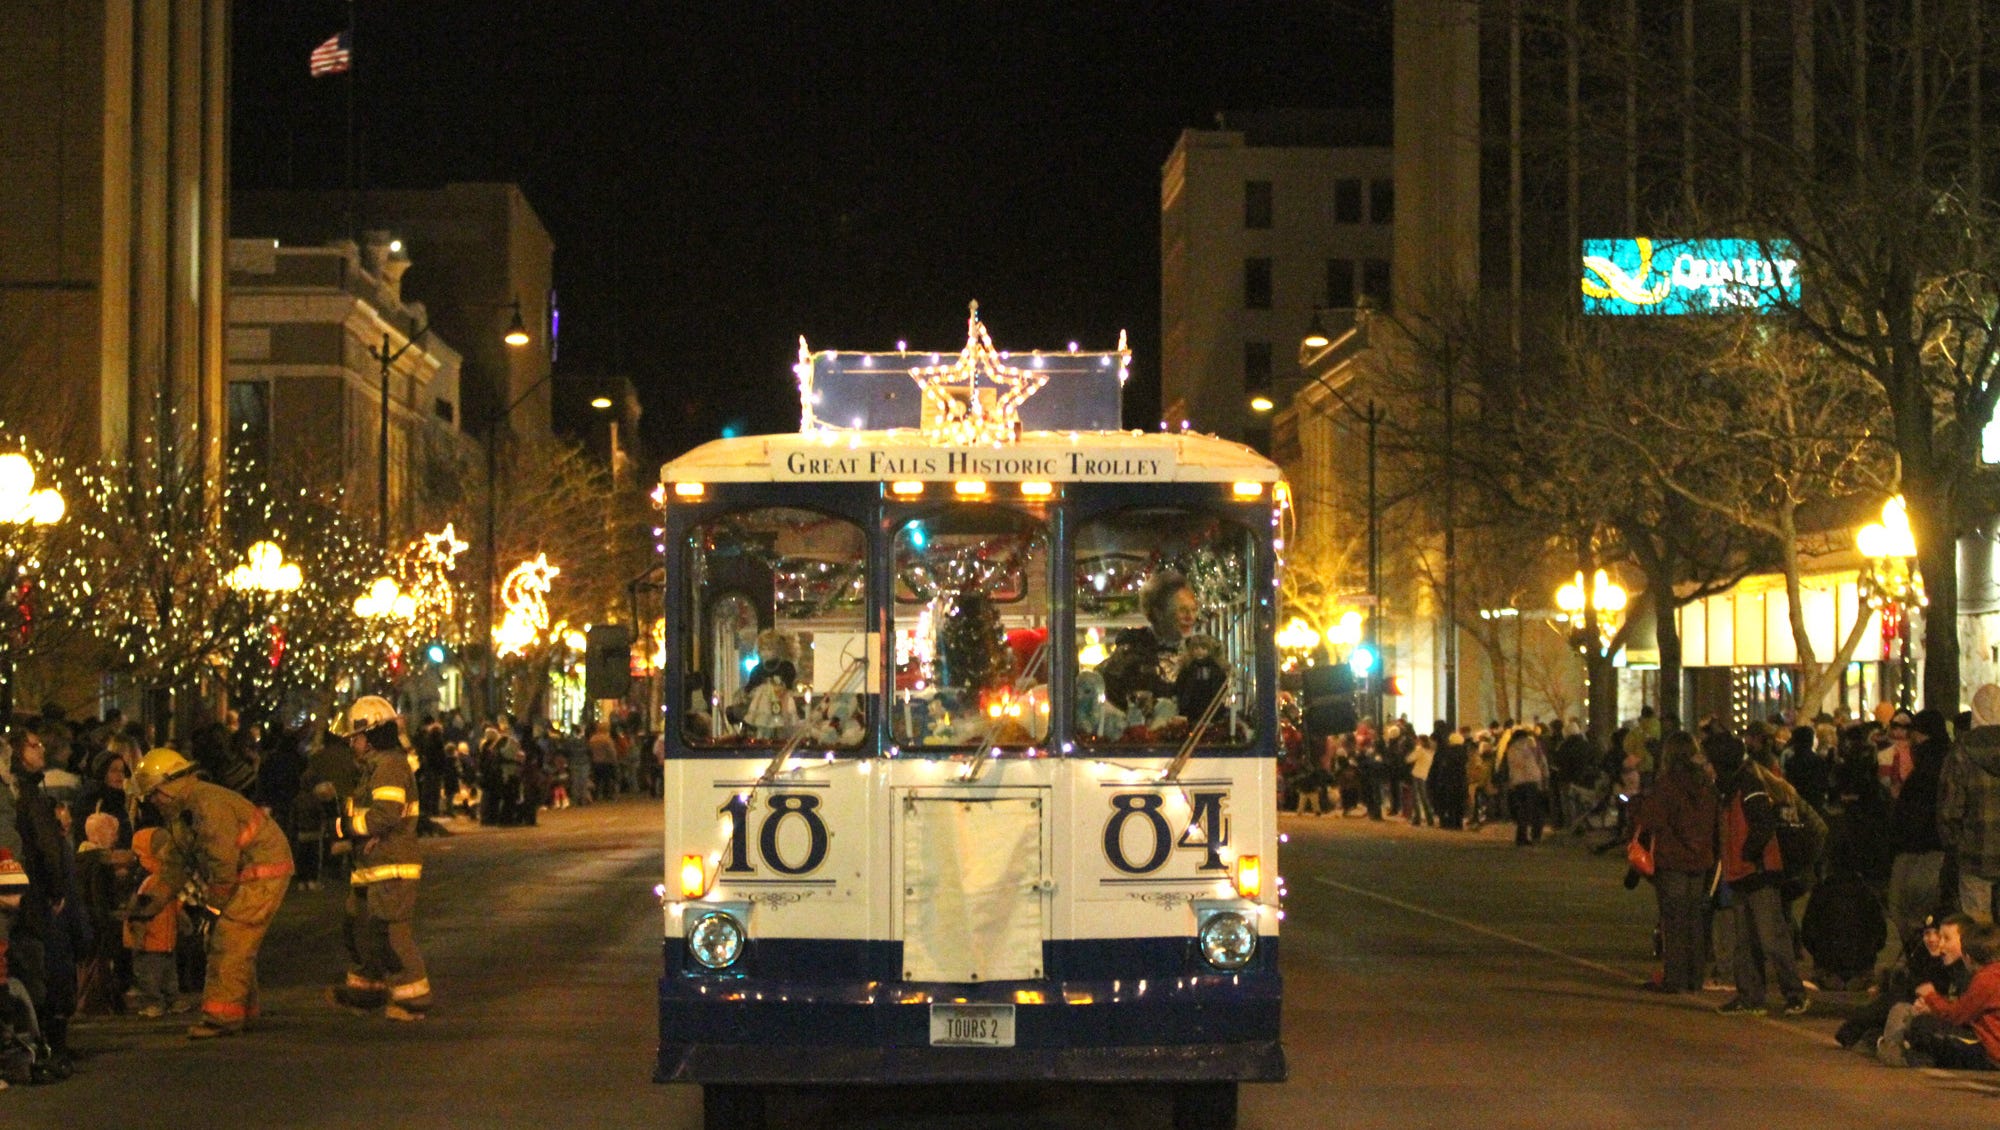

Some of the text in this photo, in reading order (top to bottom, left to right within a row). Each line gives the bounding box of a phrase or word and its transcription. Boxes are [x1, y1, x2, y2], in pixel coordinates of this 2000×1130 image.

[1672, 253, 1797, 290] QUALITY
[787, 451, 1161, 476] GREAT FALLS HISTORIC TROLLEY
[717, 791, 831, 877] 18
[1101, 789, 1232, 876] 84
[947, 1019, 998, 1038] TOURS 2
